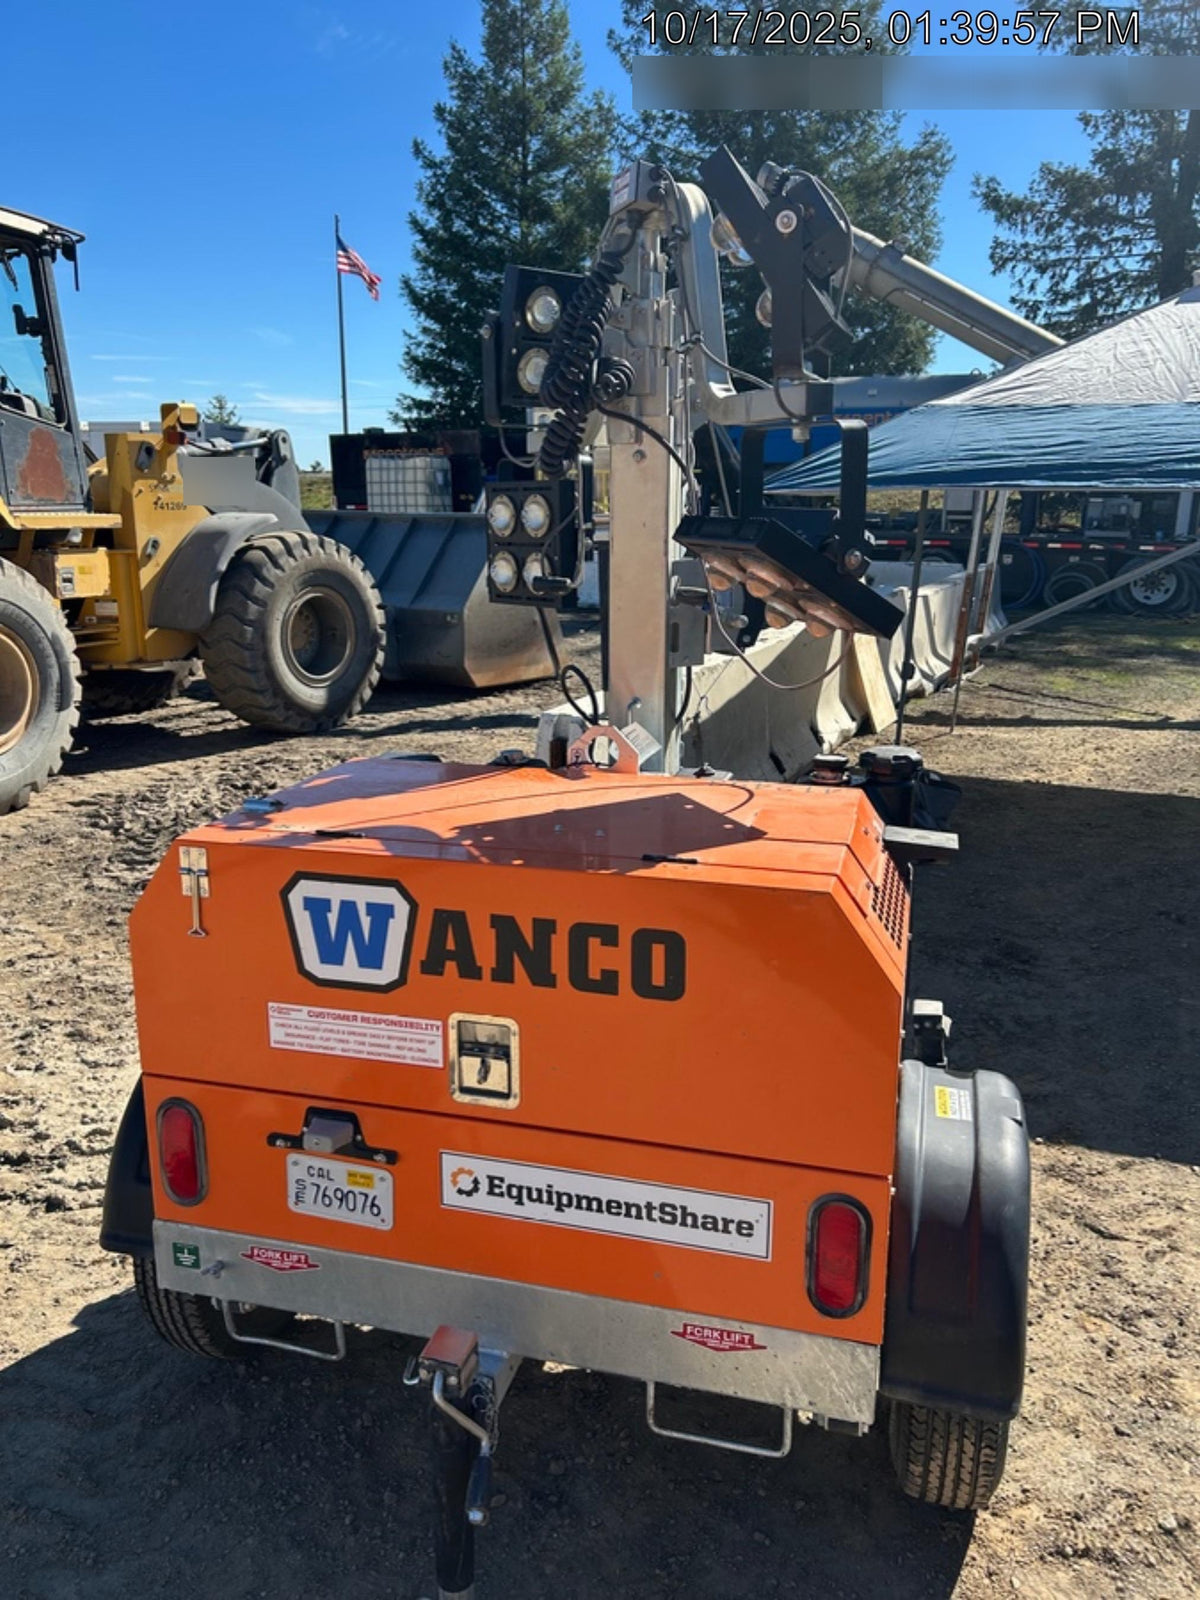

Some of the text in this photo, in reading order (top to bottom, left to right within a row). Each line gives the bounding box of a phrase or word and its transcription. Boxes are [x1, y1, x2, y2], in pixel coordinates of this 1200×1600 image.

[303, 896, 686, 1001] WANCO
[307, 1010, 358, 1023] CUSTOMER
[361, 1016, 441, 1032] RESPONSIBILITY
[307, 1165, 335, 1181] CAL
[310, 1182, 382, 1217] 769076
[485, 1174, 755, 1239] EquipmentShare
[253, 1248, 281, 1260] FORK
[283, 1252, 306, 1264] LIFT
[686, 1325, 720, 1339] FORK
[723, 1331, 751, 1344] LIFT
